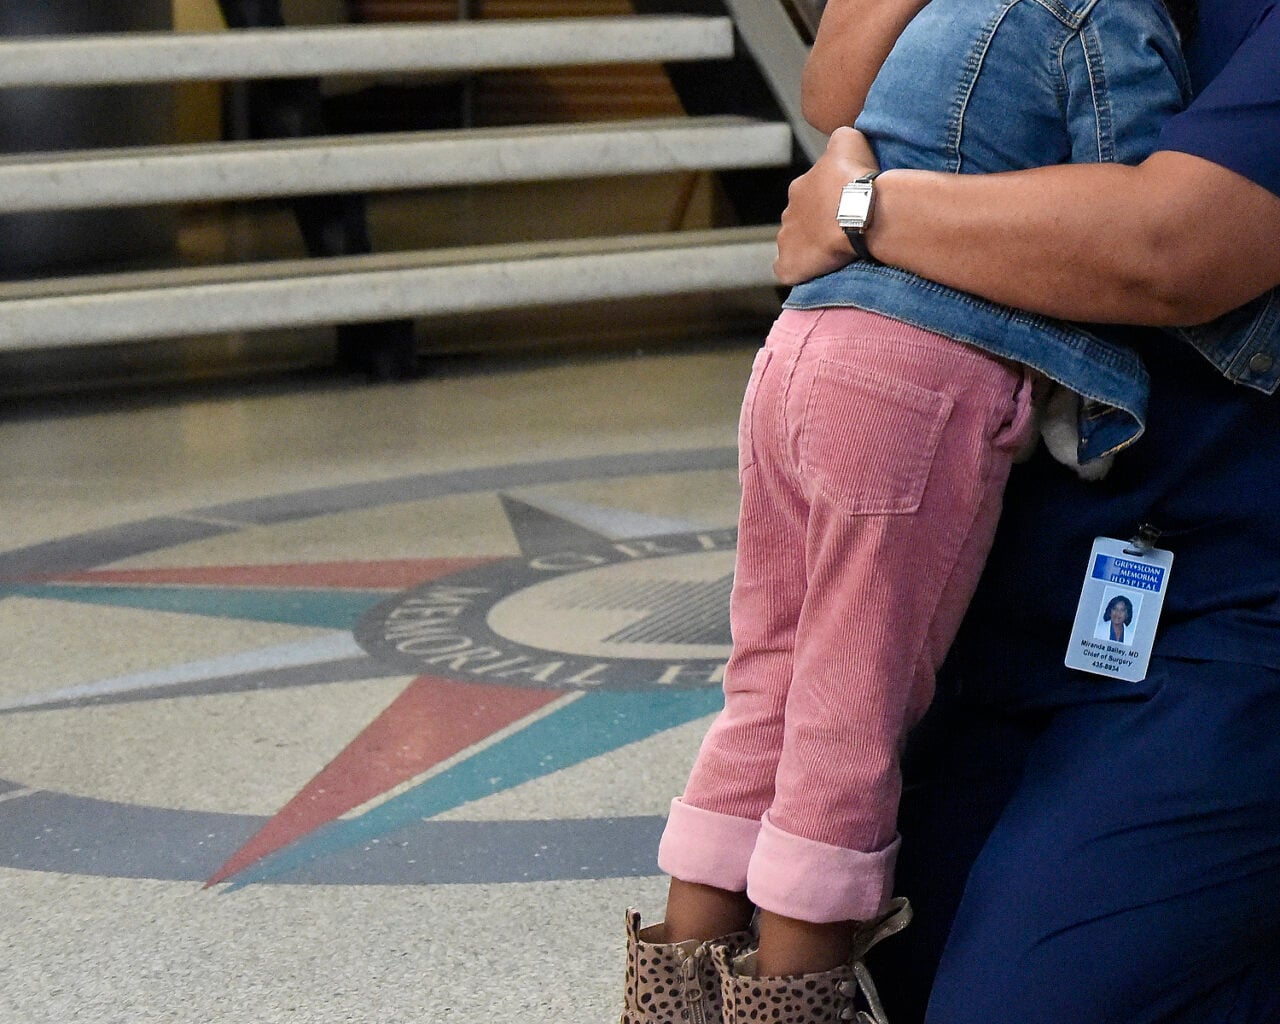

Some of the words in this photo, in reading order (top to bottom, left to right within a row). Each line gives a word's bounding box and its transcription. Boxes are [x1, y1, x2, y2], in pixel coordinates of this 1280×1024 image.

[1111, 575, 1157, 591] HOSPITAL
[1120, 569, 1158, 582] MEMORIAL
[383, 584, 610, 687] MEMORIAL
[1081, 639, 1105, 650] Miranda
[1106, 645, 1127, 656] Bailey,
[1129, 650, 1139, 658] MD
[1083, 649, 1100, 658] Chief
[1108, 655, 1133, 667] Surgery
